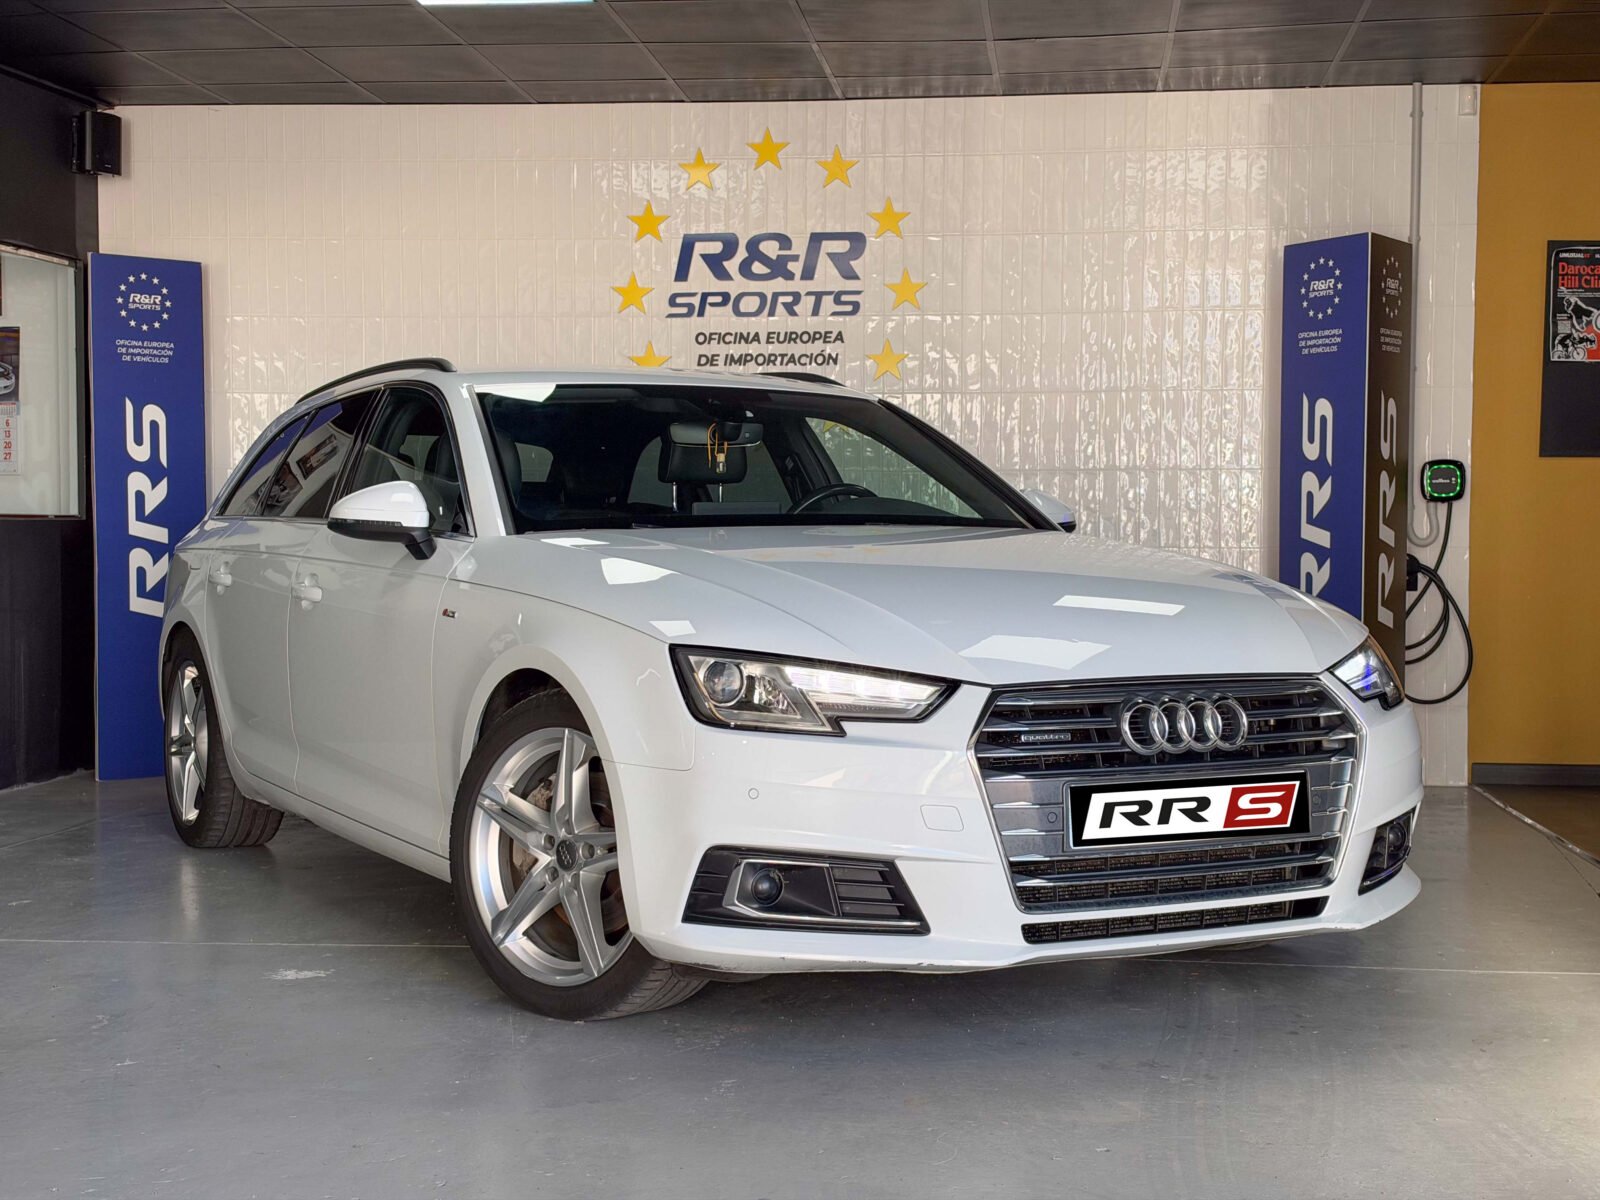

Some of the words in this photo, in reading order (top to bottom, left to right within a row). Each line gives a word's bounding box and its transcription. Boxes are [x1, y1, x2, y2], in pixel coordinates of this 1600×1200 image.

[673, 232, 867, 282] R&R
[1558, 262, 1600, 275] Daroca
[1309, 278, 1335, 291] R&R
[1558, 275, 1579, 288] Hill
[1582, 275, 1600, 288] Cli
[129, 293, 162, 305] R&R
[1309, 289, 1334, 298] SPORTS
[128, 303, 161, 311] SPORTS
[665, 290, 865, 318] SPORTS
[694, 331, 762, 346] OFICINA
[765, 330, 845, 345] EUROPEA
[1298, 330, 1318, 339] OFICINA
[1318, 328, 1343, 337] EUROPEA
[115, 339, 143, 347] OFICINA
[143, 341, 175, 349] EUROPEA
[1306, 337, 1342, 346] IMPORTACIÓN
[128, 347, 173, 356] IMPORTACIÓN
[1301, 347, 1309, 355] DE
[1309, 345, 1338, 354] VEHÍCULOS
[133, 355, 169, 363] VEHÍCULOS
[696, 353, 720, 367] DE
[723, 350, 839, 367] IMPORTACIÓN
[5, 419, 10, 427] 6
[4, 430, 11, 438] 13
[4, 441, 12, 449] 20
[4, 452, 12, 460] 27
[1300, 391, 1334, 599] RRS
[125, 396, 169, 618] RRS
[1377, 389, 1397, 629] RRS
[1024, 734, 1069, 742] quattro
[1099, 790, 1287, 829] RRS
